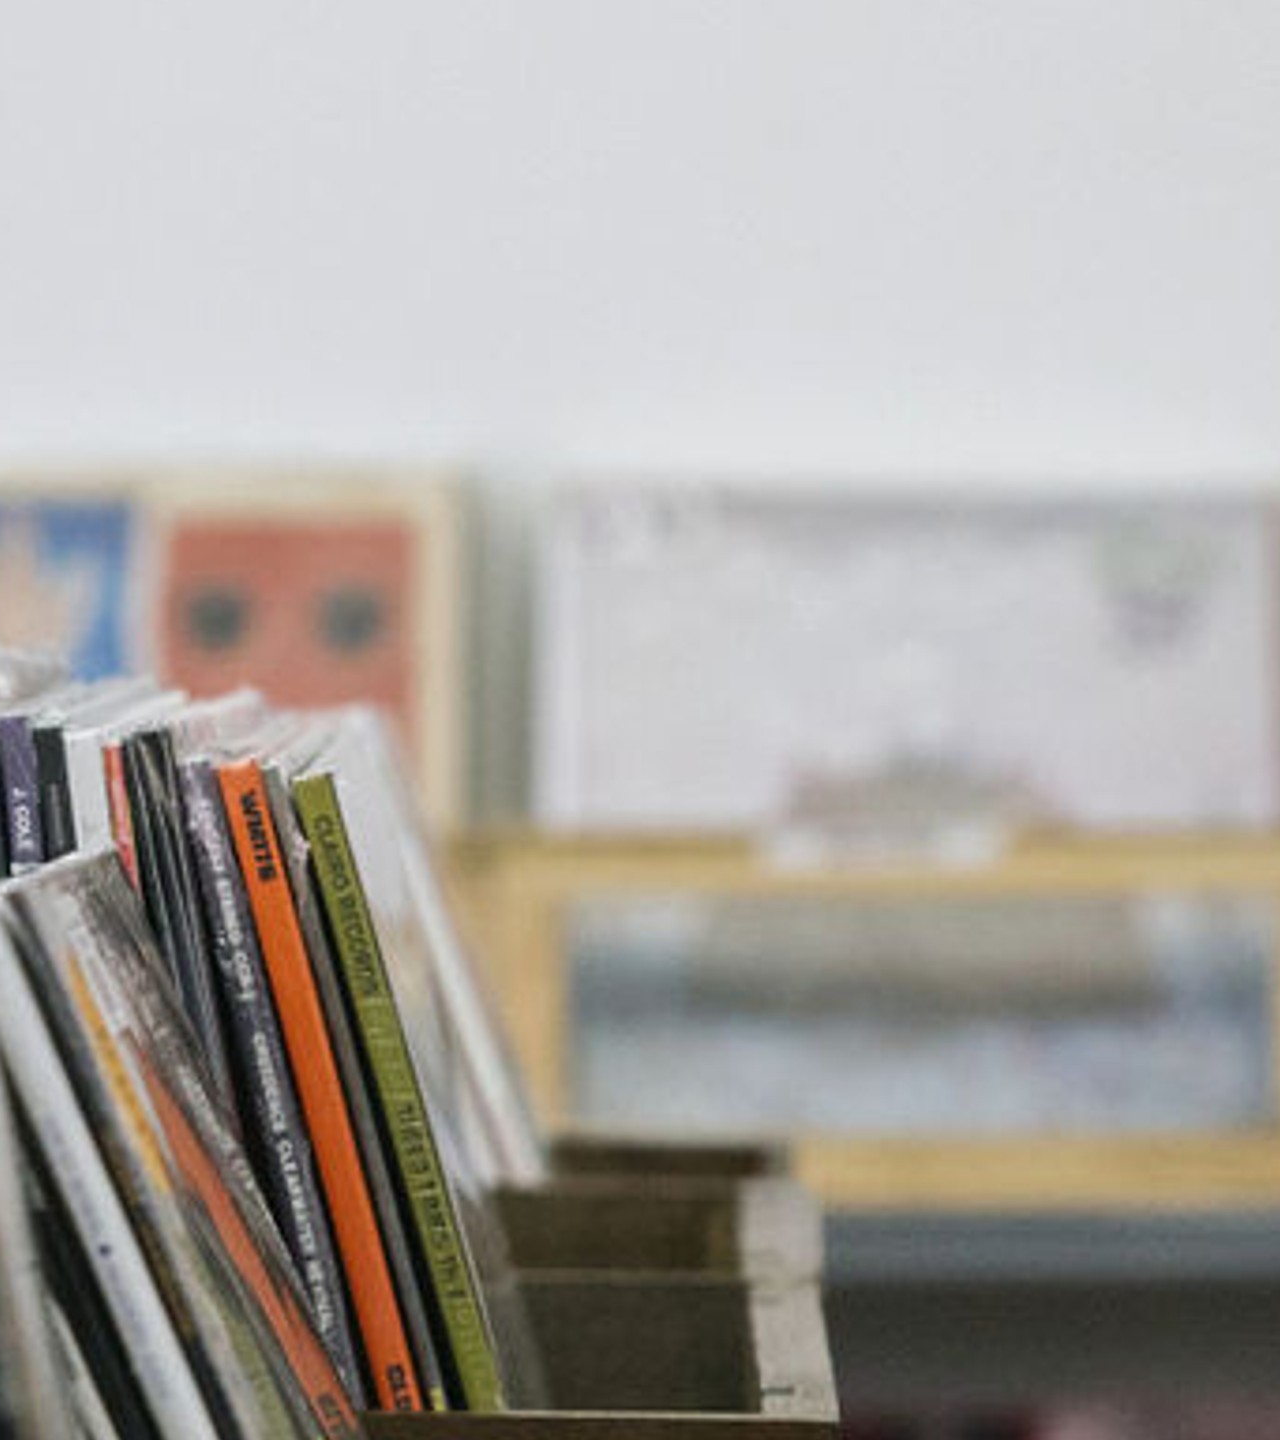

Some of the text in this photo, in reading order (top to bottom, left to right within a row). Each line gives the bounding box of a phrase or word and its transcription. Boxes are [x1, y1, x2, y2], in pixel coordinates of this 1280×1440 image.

[14, 804, 35, 850] COLE
[276, 1138, 317, 1253] CLEARWATER
[307, 1260, 335, 1333] REVIVAL
